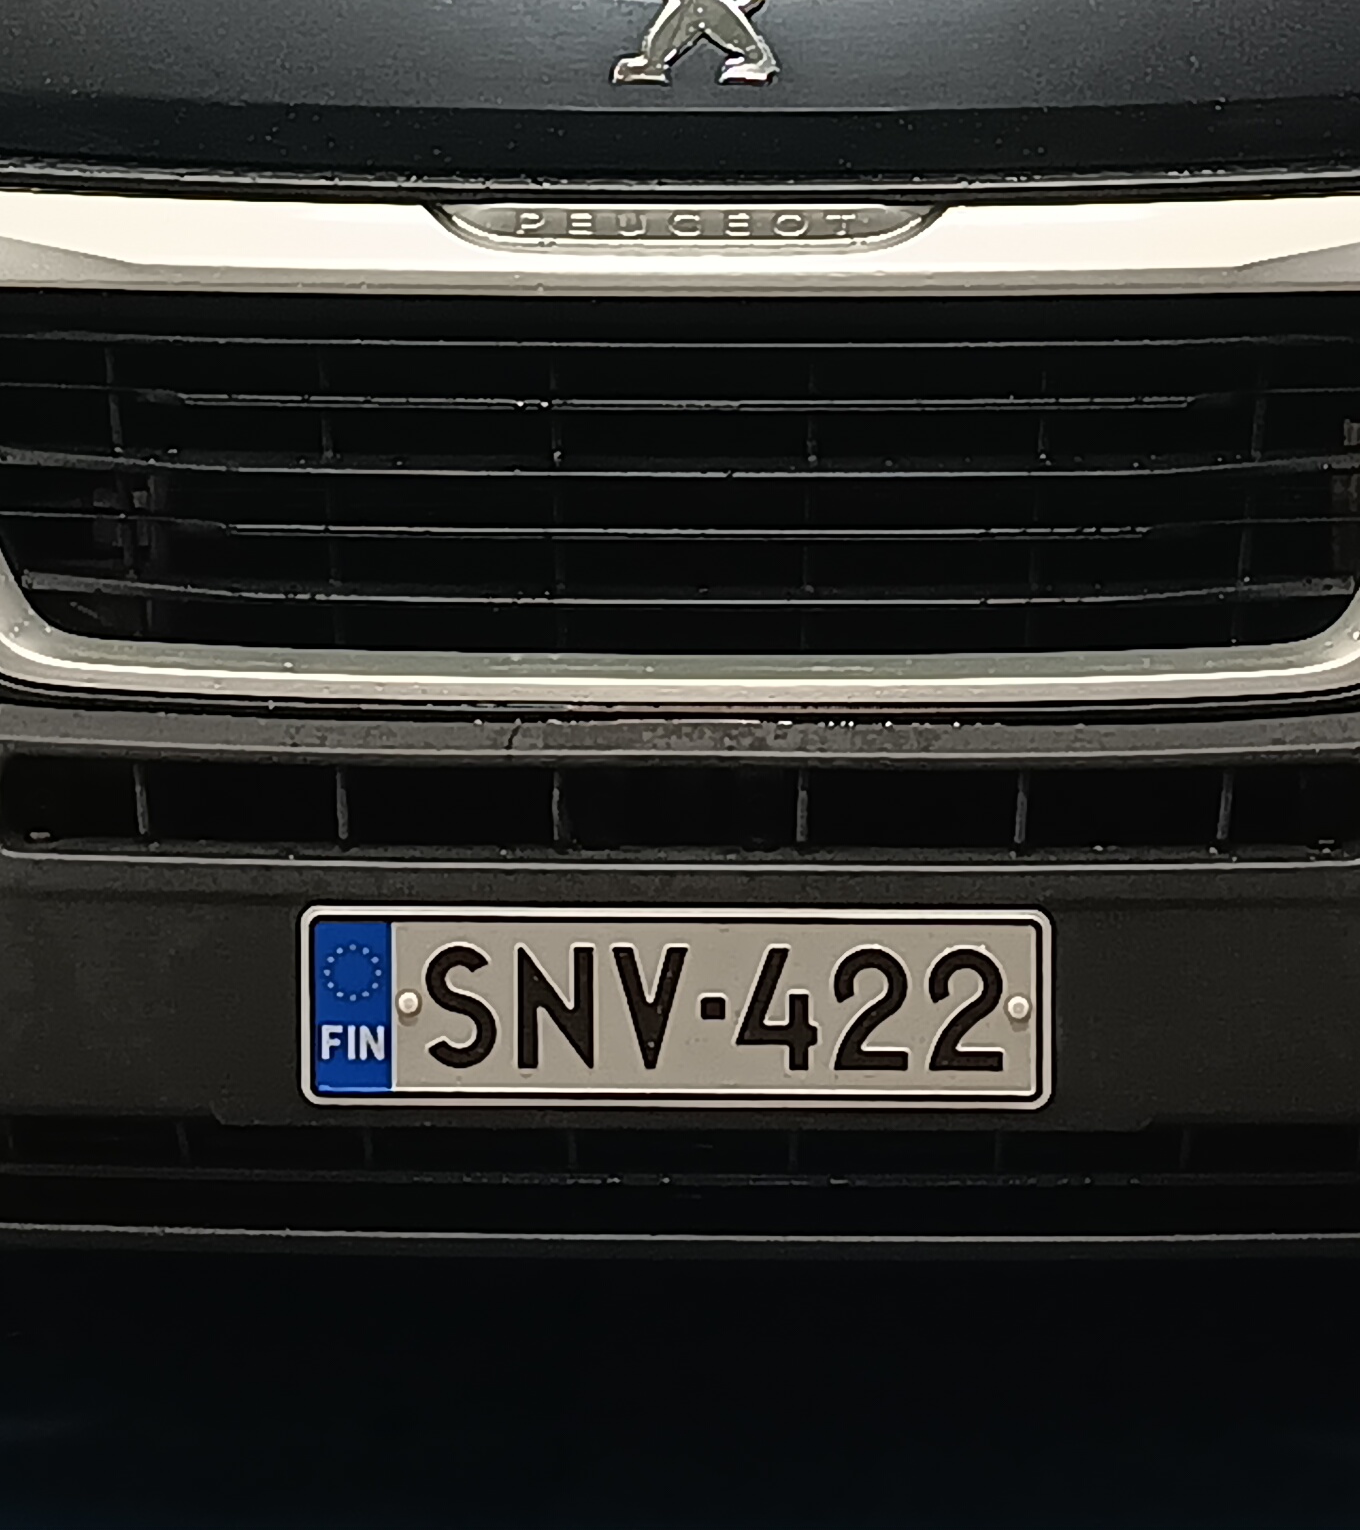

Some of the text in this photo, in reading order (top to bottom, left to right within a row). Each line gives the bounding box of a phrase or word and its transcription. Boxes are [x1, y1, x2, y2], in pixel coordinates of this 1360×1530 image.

[515, 212, 857, 238] PEUGEOT
[424, 944, 1005, 1070] SNV-422
[320, 1025, 386, 1061] FIN
